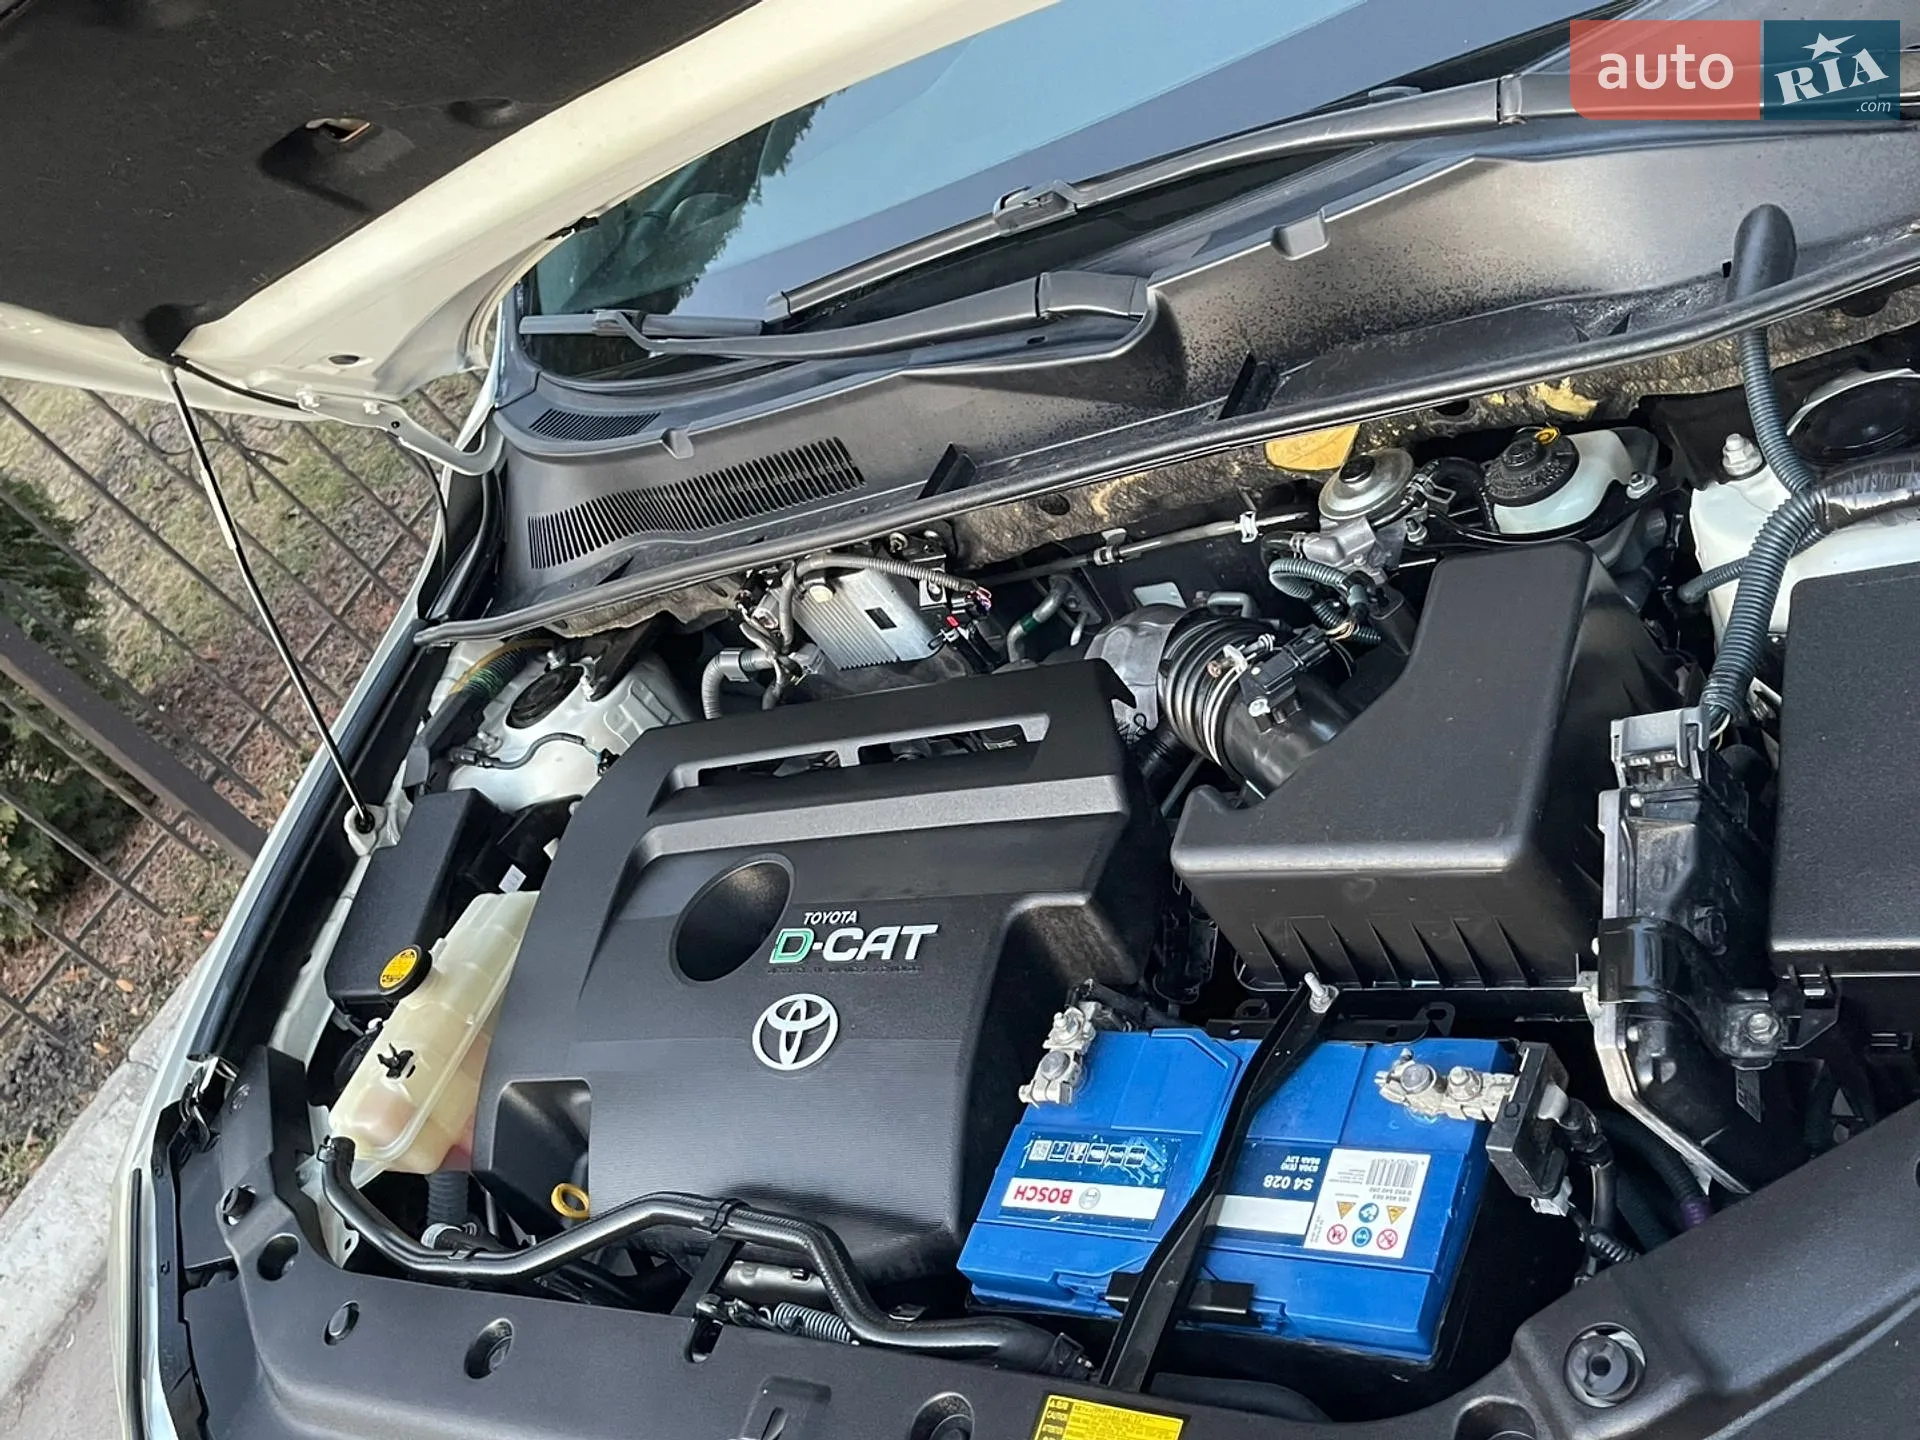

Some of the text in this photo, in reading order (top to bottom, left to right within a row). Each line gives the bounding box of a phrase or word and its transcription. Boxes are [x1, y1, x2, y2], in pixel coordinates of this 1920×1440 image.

[803, 910, 858, 925] TOYOTA
[769, 924, 939, 964] D-CAT
[1263, 1174, 1314, 1191] S4 028
[1013, 1185, 1073, 1204] BOSCH
